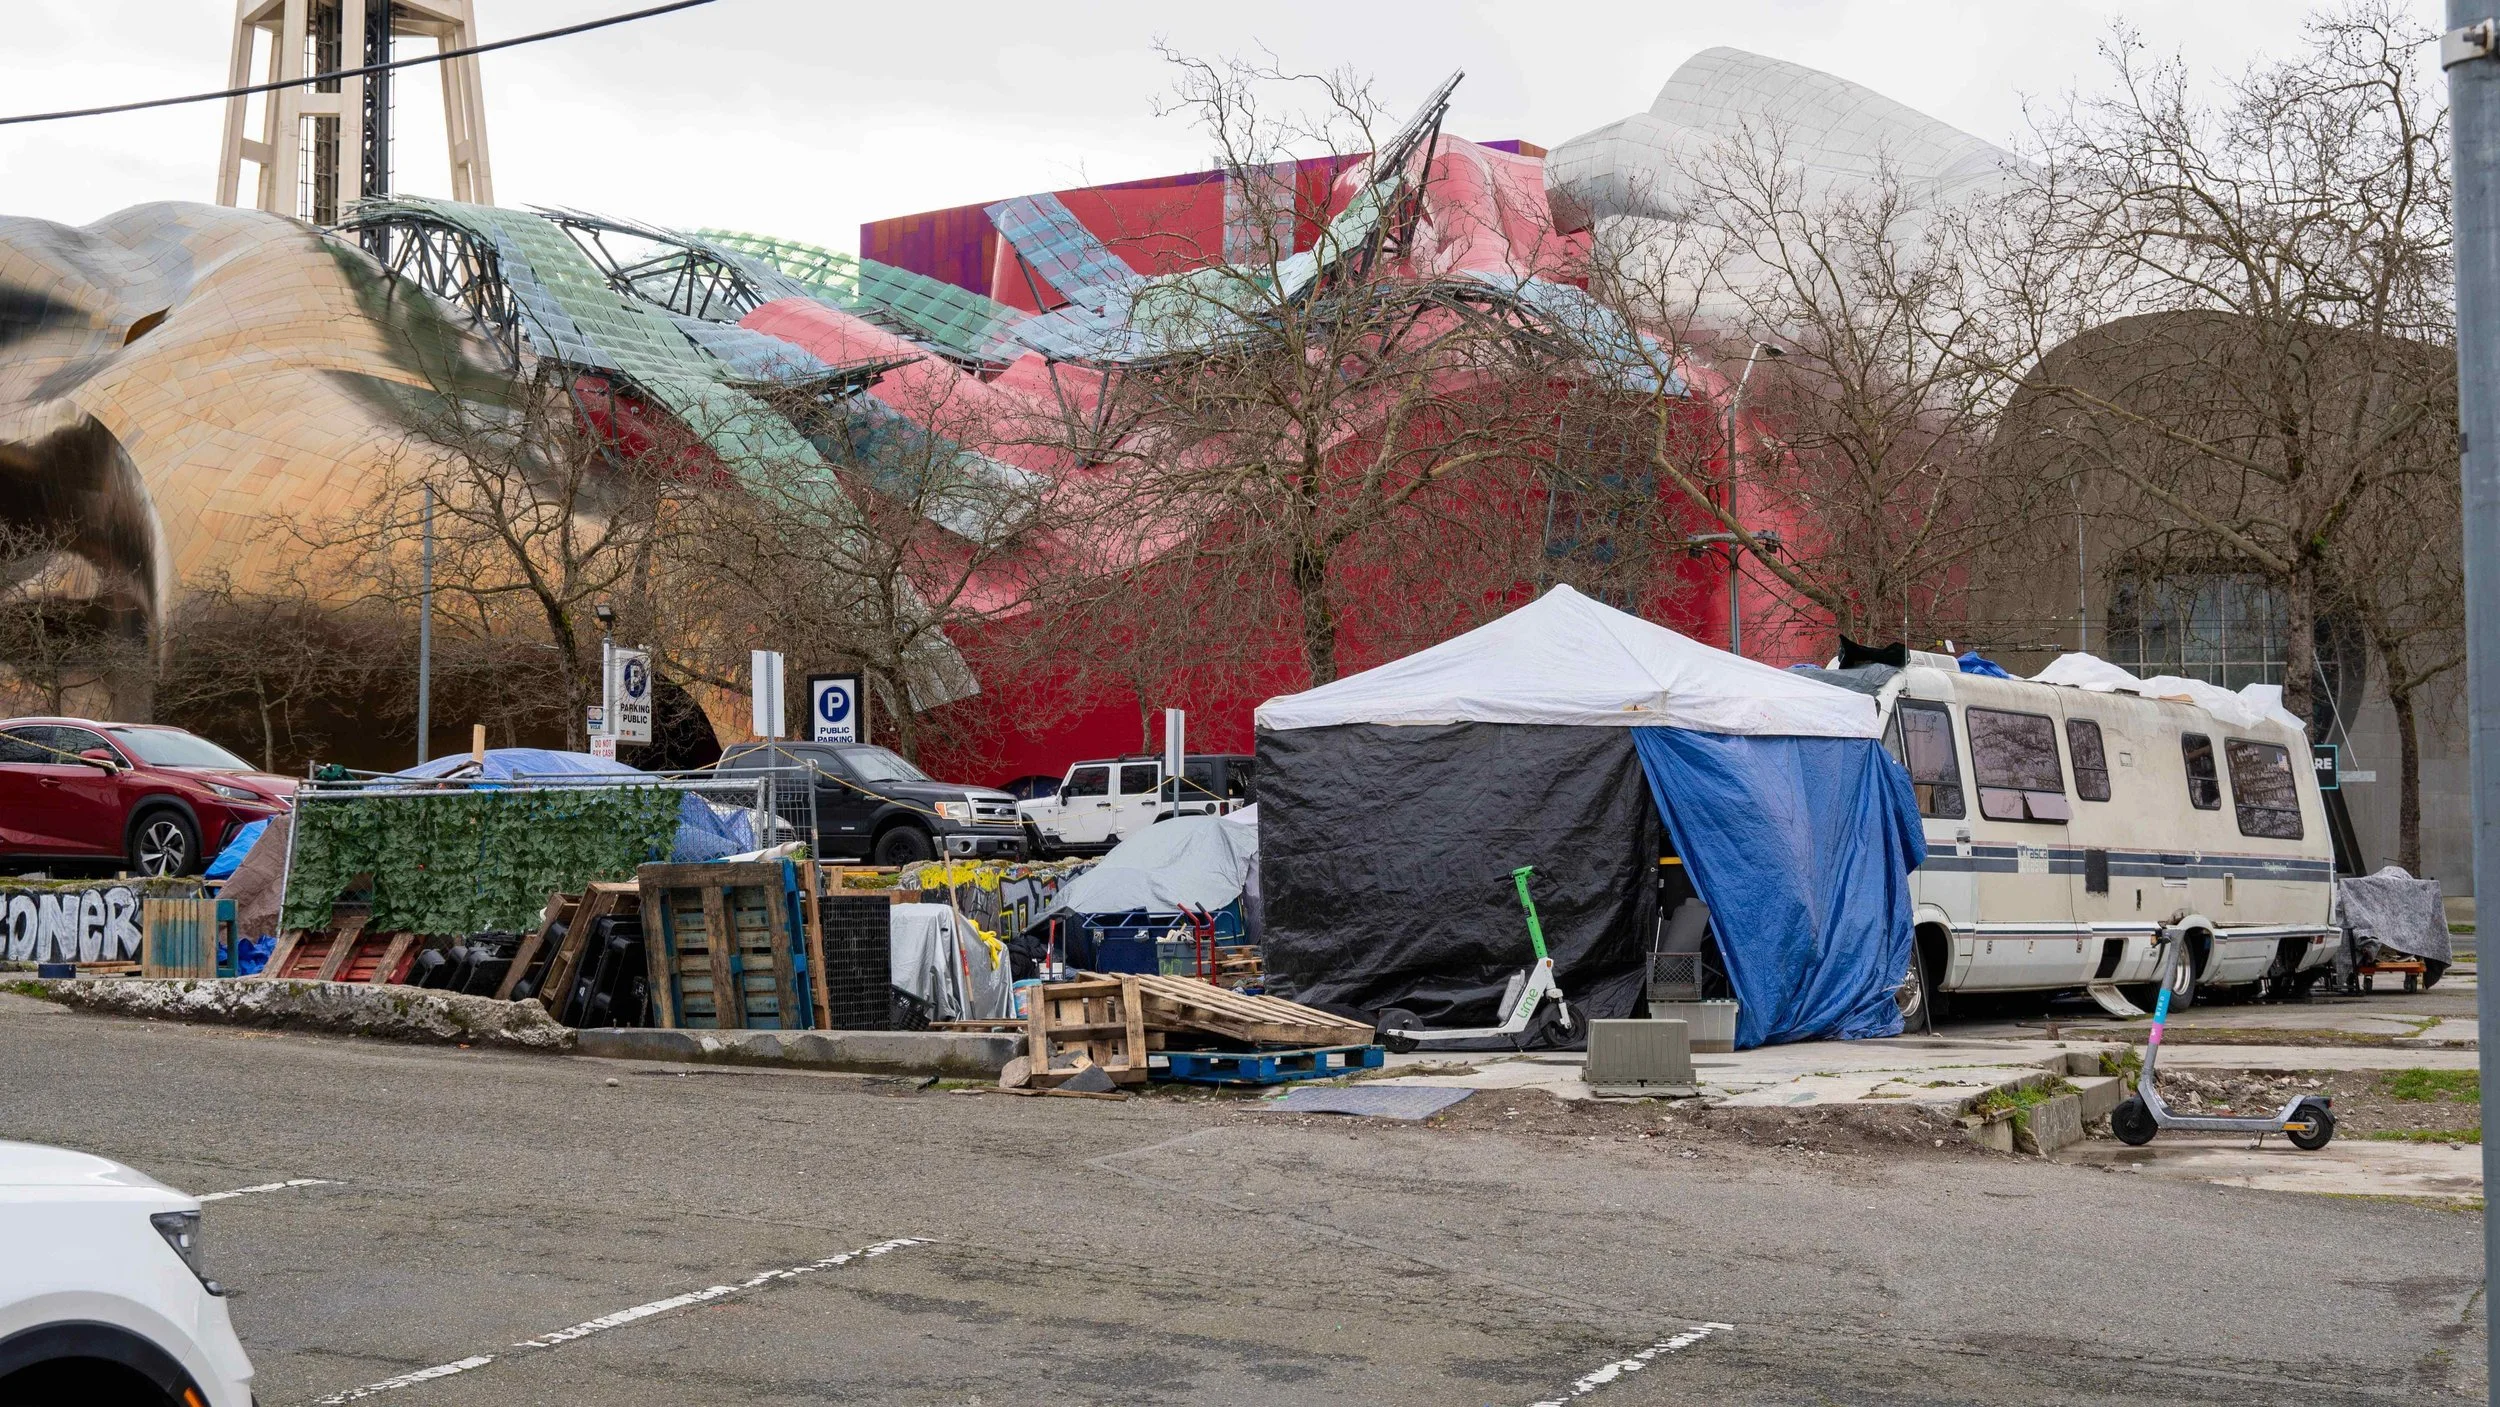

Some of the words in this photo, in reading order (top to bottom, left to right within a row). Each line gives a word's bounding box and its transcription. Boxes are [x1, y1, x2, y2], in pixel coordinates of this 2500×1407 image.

[620, 702, 650, 714] PARKING
[827, 692, 844, 717] P
[622, 714, 648, 724] PUBLIC
[820, 726, 850, 734] PUBLIC
[595, 739, 601, 748] DO
[602, 739, 612, 748] NOT
[817, 735, 853, 743] PARKING
